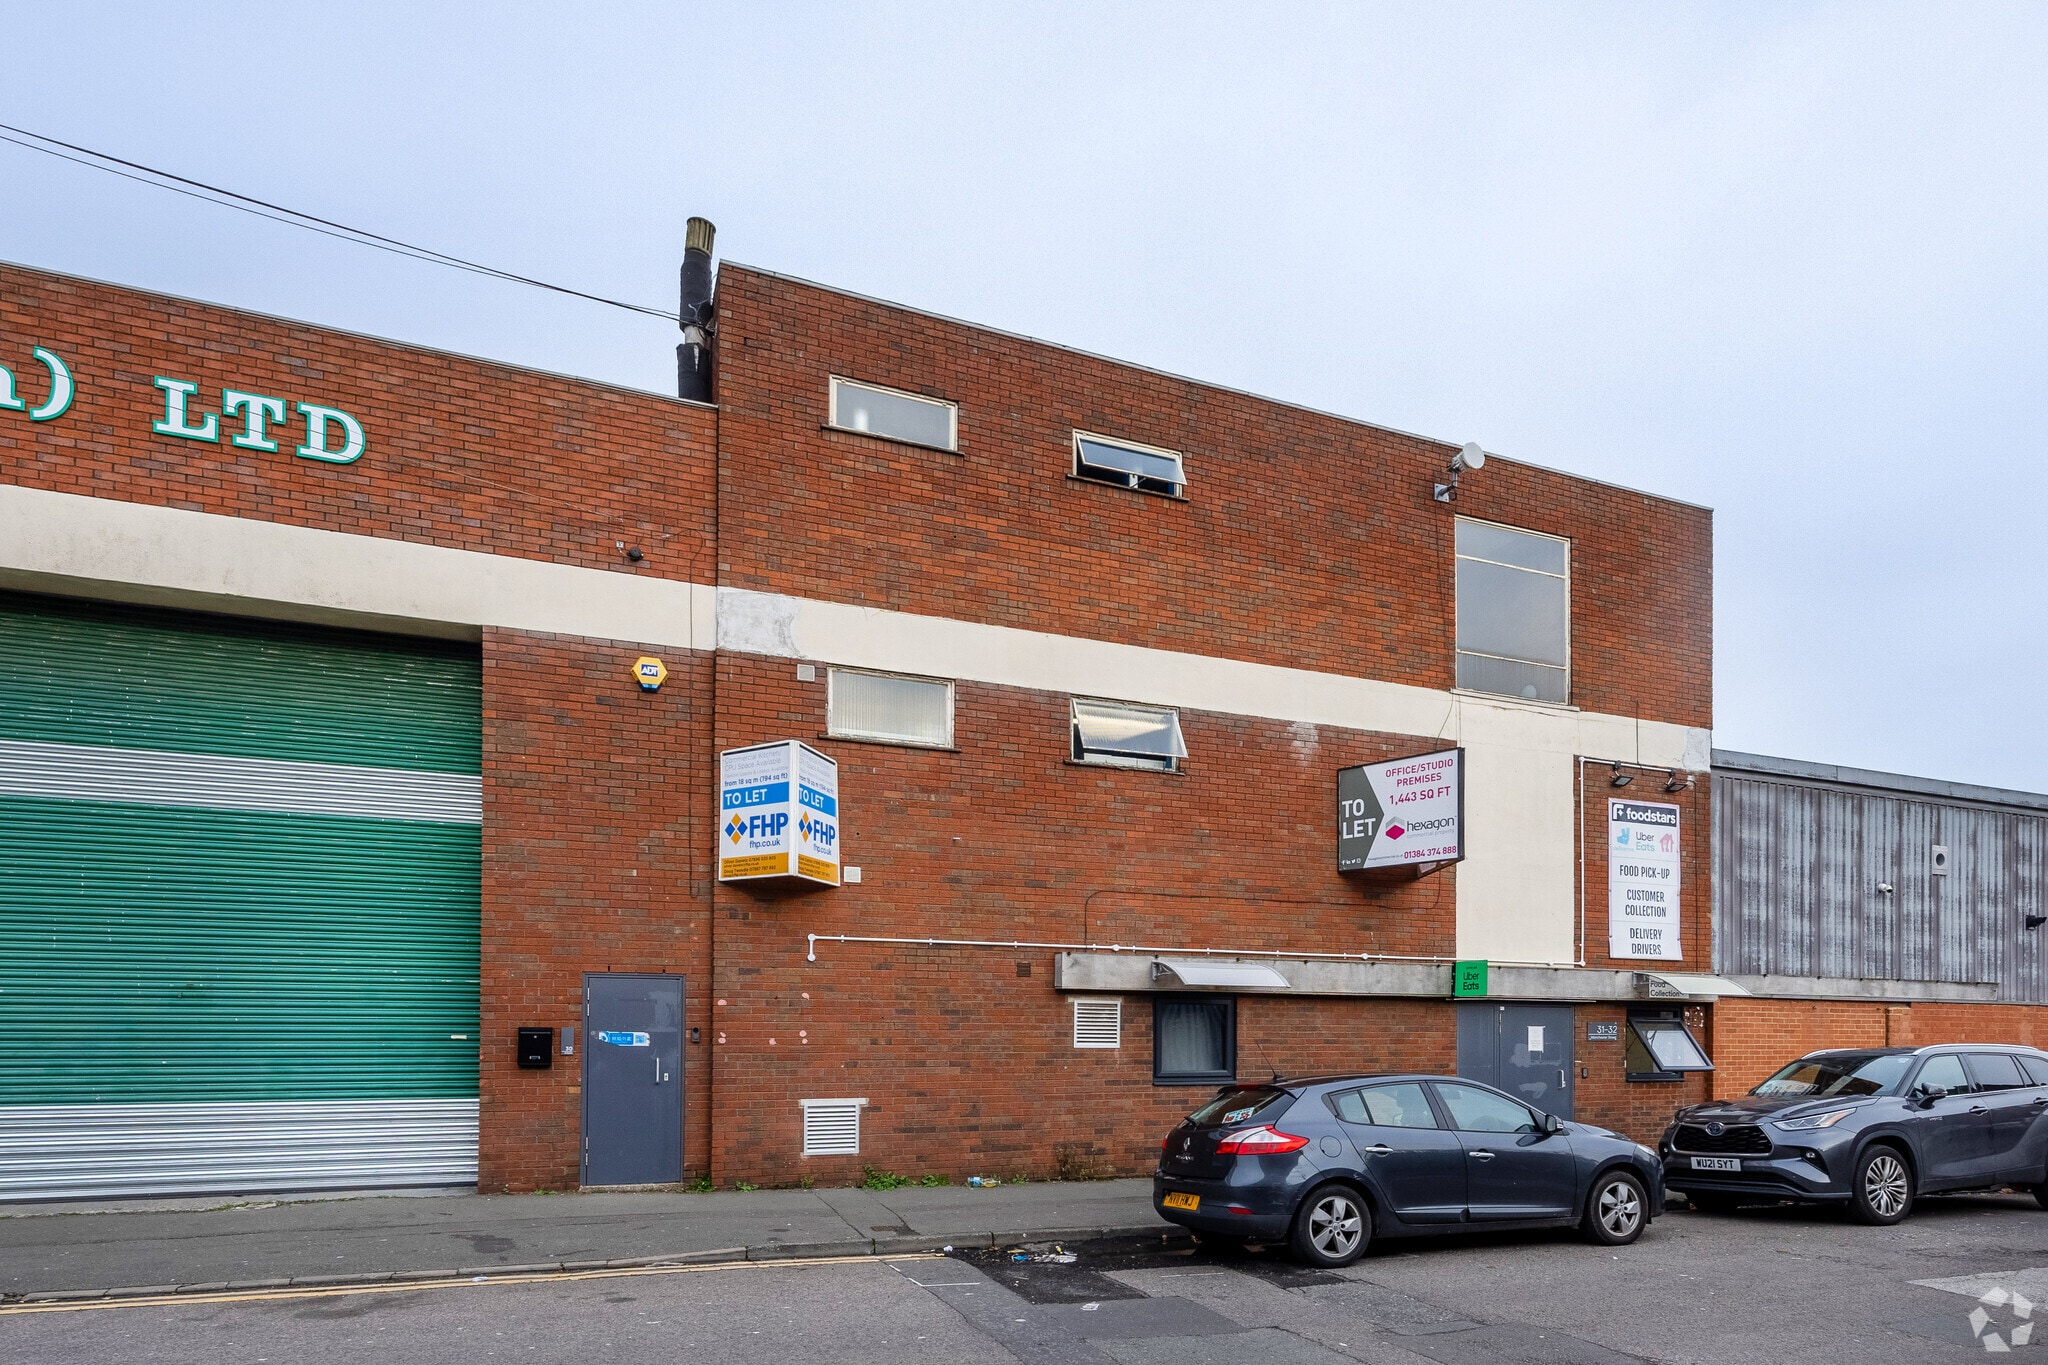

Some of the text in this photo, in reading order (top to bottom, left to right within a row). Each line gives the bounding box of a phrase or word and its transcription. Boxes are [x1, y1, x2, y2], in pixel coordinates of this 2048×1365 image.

[153, 375, 366, 464] LTD
[641, 666, 658, 676] ADT
[1385, 758, 1453, 778] OFFICE/STUDIO
[1396, 772, 1442, 788] PREMISES
[725, 789, 767, 806] TO LET
[799, 787, 824, 809] TO LET
[1389, 786, 1451, 805] 1,443 SQ FT
[1342, 798, 1365, 818] TO
[1626, 808, 1676, 824] foodstars
[750, 812, 789, 838] FHP
[1343, 818, 1376, 839] LET
[1407, 817, 1455, 832] hexagon
[814, 820, 836, 846] FHP
[1635, 832, 1655, 842] Uber
[749, 838, 781, 849] fhp.co.uk
[1635, 842, 1656, 852] Eats
[1404, 849, 1425, 860] 01384
[1427, 847, 1441, 857] 374
[1442, 846, 1457, 856] 888
[1619, 865, 1670, 879] FOOD PICK-UP
[1626, 889, 1664, 903] CUSTOMER
[1625, 904, 1667, 917] COLLECTION
[1629, 928, 1662, 940] DELIVERY
[1631, 943, 1662, 955] DRIVERS
[1463, 972, 1479, 980] Uber
[1463, 982, 1479, 991] Eats
[1650, 980, 1666, 988] Food
[1650, 989, 1679, 997] Collection
[1597, 1025, 1617, 1034] 31-32
[1696, 1158, 1734, 1169] WU21 SYT
